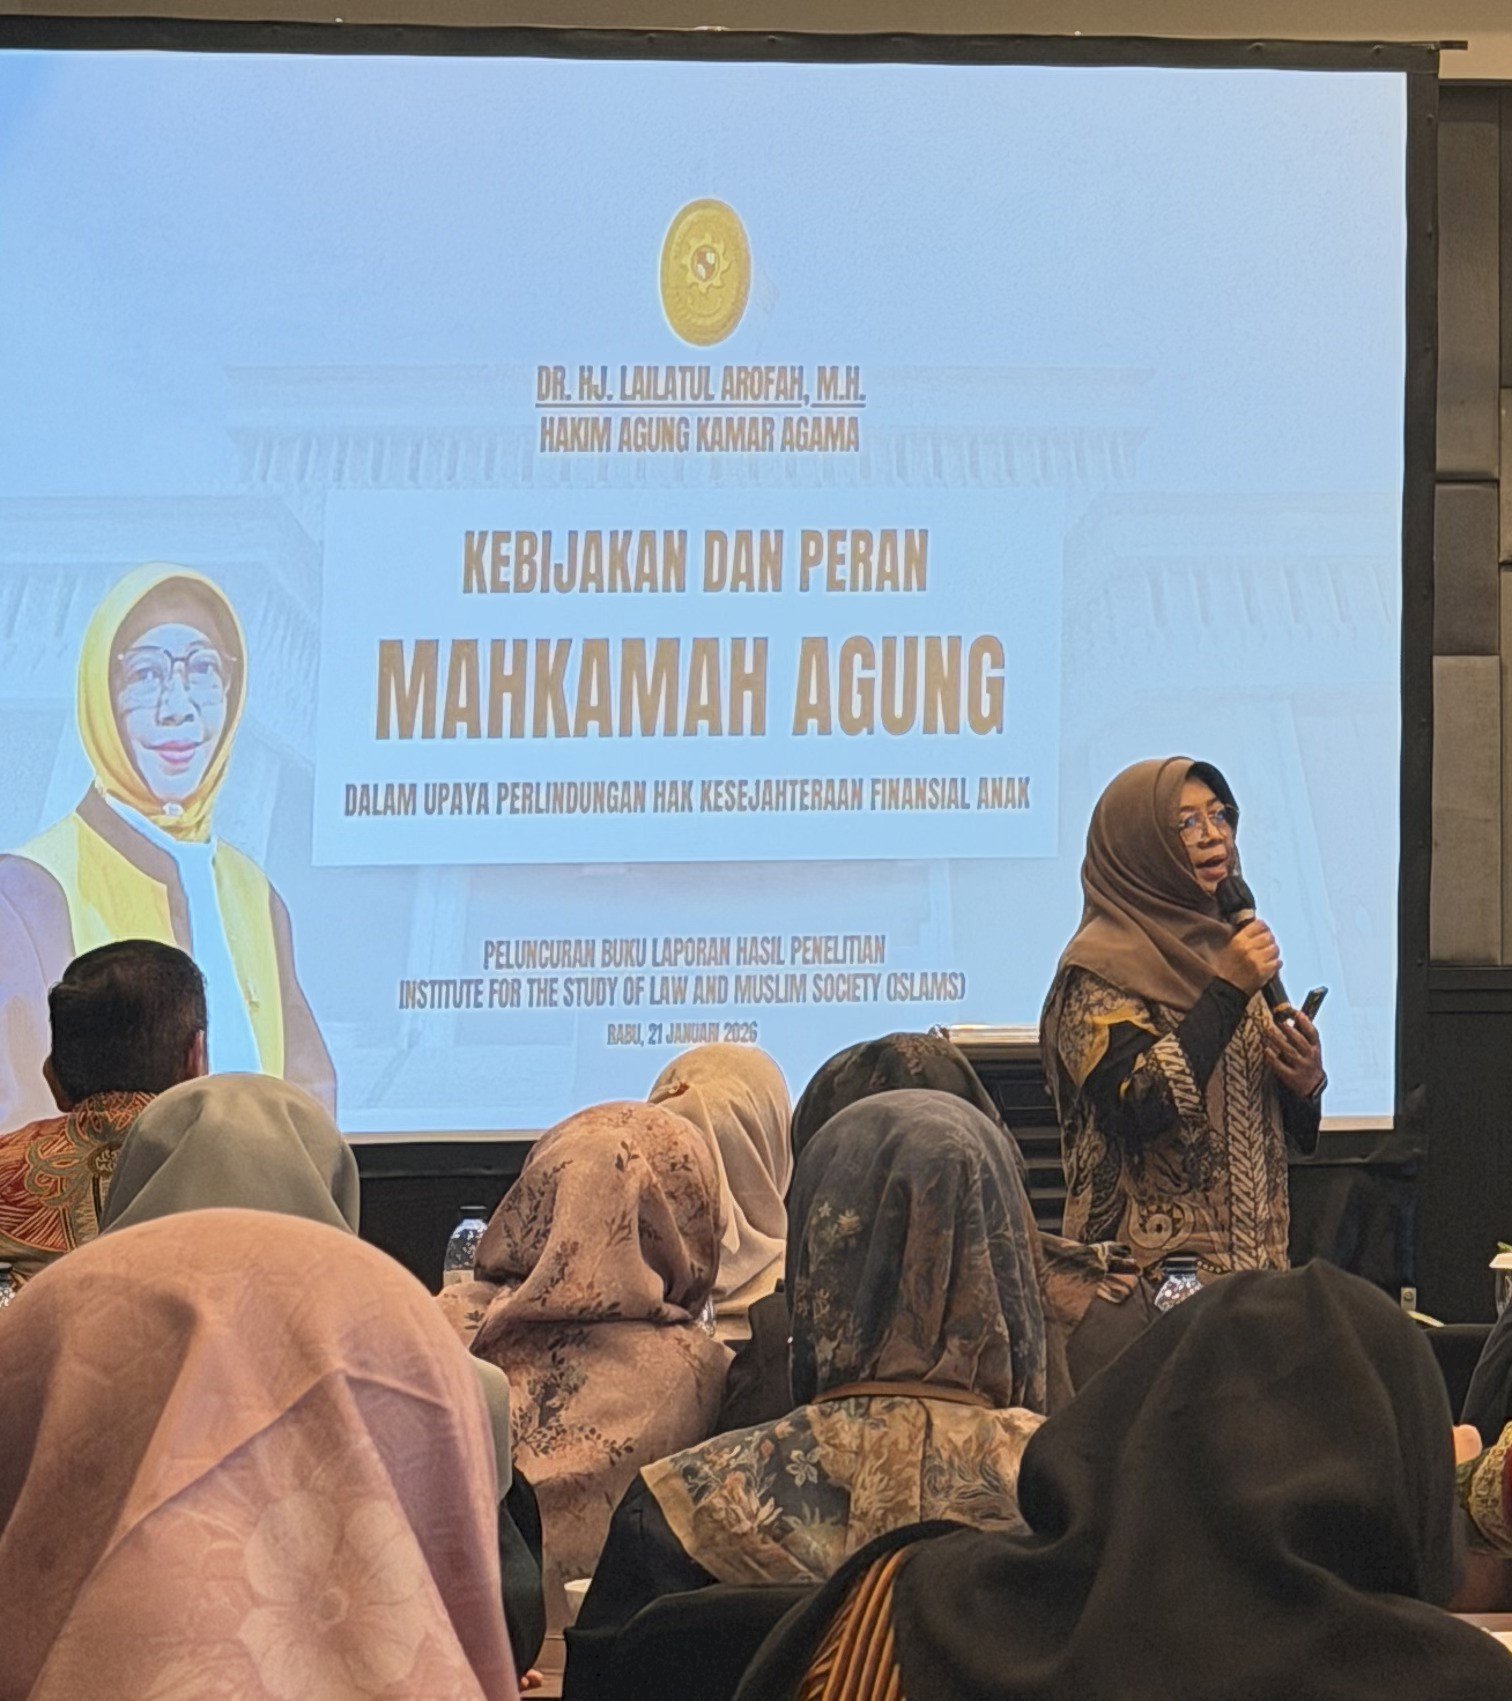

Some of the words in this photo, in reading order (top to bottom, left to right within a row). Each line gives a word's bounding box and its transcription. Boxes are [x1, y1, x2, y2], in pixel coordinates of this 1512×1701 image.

[538, 366, 571, 401] DR.
[578, 366, 613, 401] HJ.
[620, 366, 715, 401] LAILATUL
[721, 365, 809, 405] AROFAH,
[816, 365, 866, 401] M.H.
[540, 417, 611, 452] HAKIM
[618, 417, 690, 452] AGUNG
[696, 417, 774, 451] KAMAR
[780, 416, 859, 451] AGAMA
[463, 529, 687, 593] KEBIJAKAN
[703, 529, 783, 592] DAN
[800, 528, 928, 592] PERAN
[376, 637, 768, 740] MAHKAMAH
[792, 635, 1005, 737] AGUNG
[344, 783, 416, 816] DALAM
[424, 782, 489, 815] UPAYA
[496, 780, 646, 815] PERLINDUNGAN
[652, 779, 693, 813] HAK
[700, 778, 863, 813] KESEJAHTERAAN
[870, 777, 970, 811] FINANSIAL
[977, 776, 1030, 810] ANAK
[483, 938, 596, 970] PELUNCURAN
[601, 937, 646, 968] BUKU
[652, 936, 730, 968] LAPORAN
[736, 935, 785, 966] HASIL
[791, 935, 886, 965] PENELITIAN
[399, 979, 483, 1009] INSTITUTE
[488, 978, 522, 1008] FOR
[527, 977, 558, 1008] THE
[563, 976, 618, 1007] STUDY
[623, 976, 645, 1006] OF
[651, 975, 688, 1005] LAW
[692, 974, 728, 1004] AND
[734, 973, 806, 1004] MUSLIM
[813, 973, 882, 1003] SOCIETY
